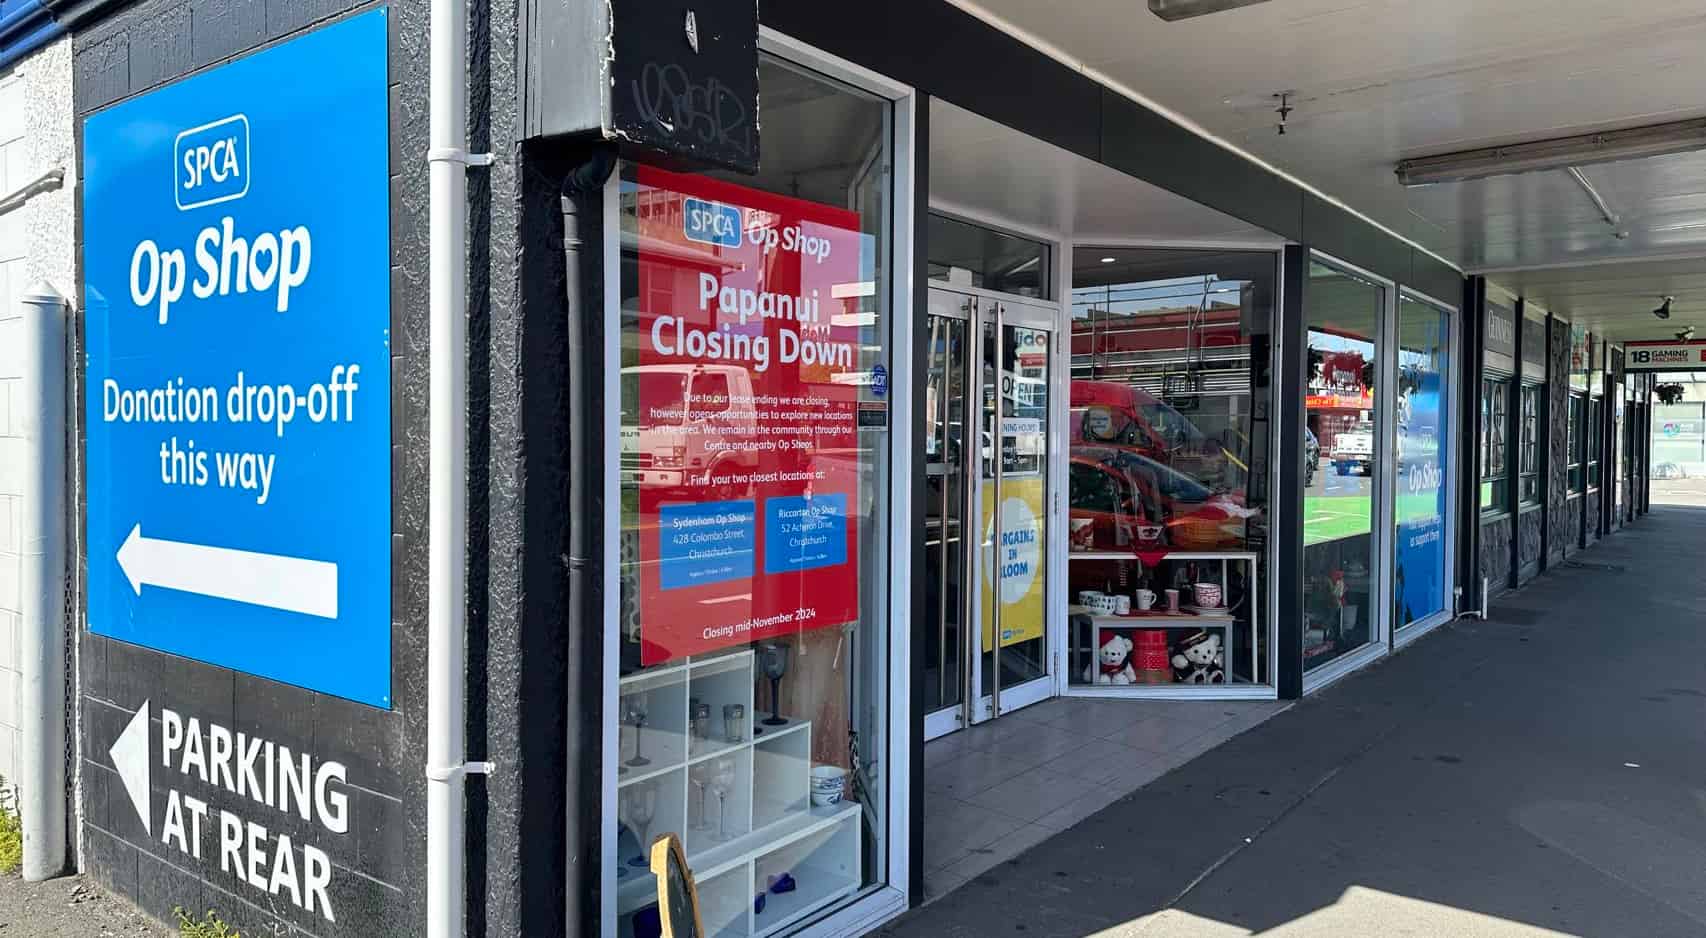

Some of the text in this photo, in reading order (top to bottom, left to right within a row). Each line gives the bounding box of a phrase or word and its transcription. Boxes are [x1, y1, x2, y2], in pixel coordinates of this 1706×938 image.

[183, 137, 240, 189] SPCA
[691, 209, 735, 238] SPCA
[748, 220, 832, 264] Op Shop
[130, 216, 312, 325] Op Shop
[699, 271, 819, 326] Papanui
[651, 314, 852, 373] Closing Down
[1631, 350, 1650, 363] 18
[1652, 349, 1689, 357] GAMING
[104, 365, 361, 438] Donation drop-off
[703, 391, 712, 403] to
[713, 393, 729, 404] our
[752, 393, 778, 407] ending
[780, 397, 791, 406] we
[792, 397, 805, 406] are
[650, 407, 689, 419] however
[690, 411, 714, 421] opens
[716, 410, 769, 422] opportunities
[771, 411, 780, 420] to
[781, 410, 808, 422] explore
[809, 412, 823, 420] new
[824, 410, 853, 421] locations
[702, 424, 716, 435] We
[719, 424, 746, 435] remain
[748, 424, 756, 435] in
[757, 424, 770, 435] the
[772, 424, 813, 437] community
[815, 424, 841, 437] through
[842, 427, 853, 435] our
[704, 439, 731, 451] Centre
[732, 440, 748, 450] and
[749, 439, 776, 452] nearby
[778, 439, 790, 452] Op
[159, 436, 276, 505] this way
[690, 473, 710, 487] Find
[711, 475, 730, 487] your
[732, 474, 748, 483] two
[749, 471, 777, 483] closest
[780, 469, 814, 481] locations
[1409, 460, 1442, 497] Op Shop
[811, 505, 821, 517] Op
[672, 512, 746, 530] Sydenham Op Shop
[780, 523, 790, 533] 52
[672, 532, 689, 545] 428
[690, 530, 723, 544] Colombo
[991, 529, 1034, 547] RGAINS
[1008, 549, 1017, 560] IN
[1000, 561, 1028, 578] LOOM
[702, 607, 817, 640] Closing mid-November 2024
[162, 708, 349, 834] PARKING
[161, 788, 337, 924] AT REAR
